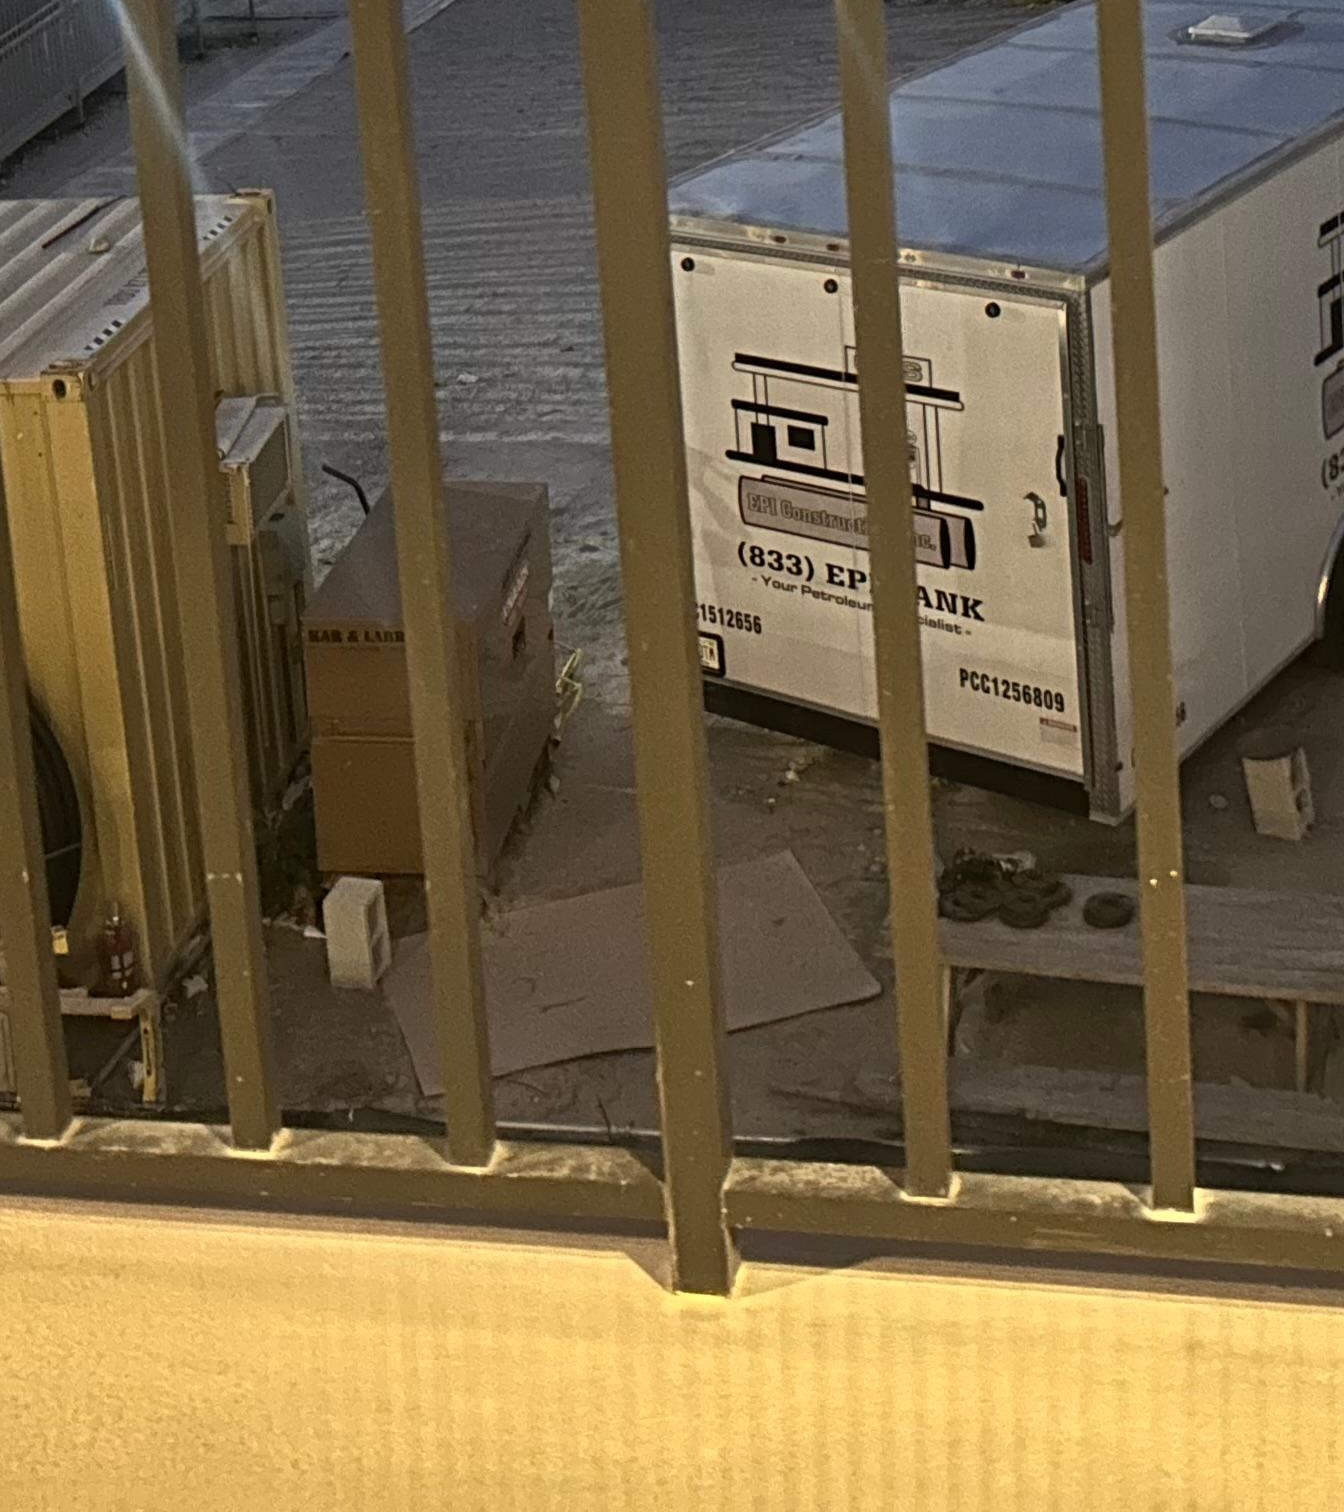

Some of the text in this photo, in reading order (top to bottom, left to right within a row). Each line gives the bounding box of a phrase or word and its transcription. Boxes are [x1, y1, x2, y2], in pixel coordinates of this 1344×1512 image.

[747, 493, 777, 516] EPI
[780, 499, 867, 535] Construct
[738, 541, 985, 621] (833) EP ANK
[760, 575, 797, 593] Your
[696, 603, 762, 634] 1512656
